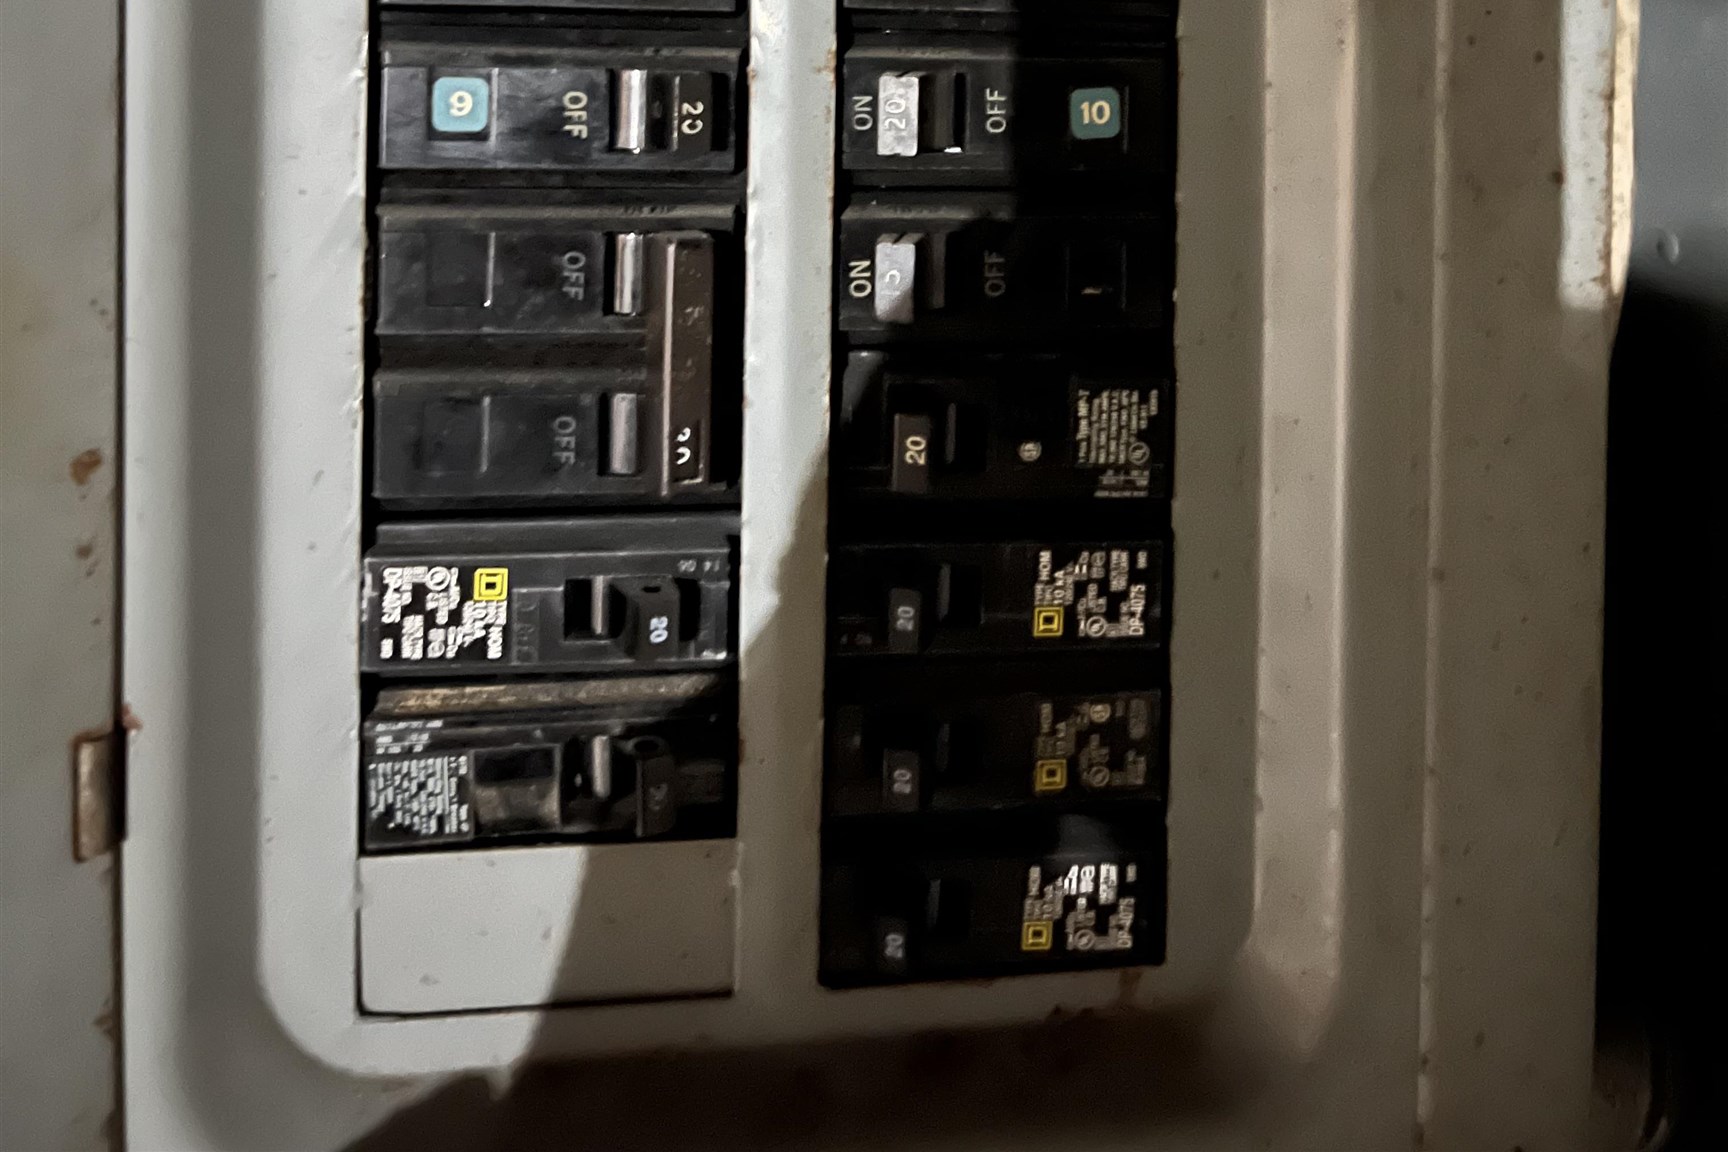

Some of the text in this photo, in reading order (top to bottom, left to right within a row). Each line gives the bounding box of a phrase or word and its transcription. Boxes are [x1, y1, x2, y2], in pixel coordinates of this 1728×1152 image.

[450, 90, 474, 118] 9
[562, 90, 589, 140] OFF
[680, 101, 705, 135] 20
[853, 95, 874, 131] ON
[883, 97, 907, 131] 20
[985, 88, 1008, 134] OFF
[1080, 101, 1111, 125] 10
[562, 250, 587, 301] OFF
[848, 258, 873, 298] ON
[983, 248, 1008, 298] OFF
[553, 415, 577, 466] OFF
[904, 435, 927, 467] 20
[1039, 550, 1052, 581] HOM
[896, 605, 916, 632] 20
[1129, 584, 1146, 636] DP-4075
[648, 616, 669, 644] 20
[892, 769, 913, 795] 20
